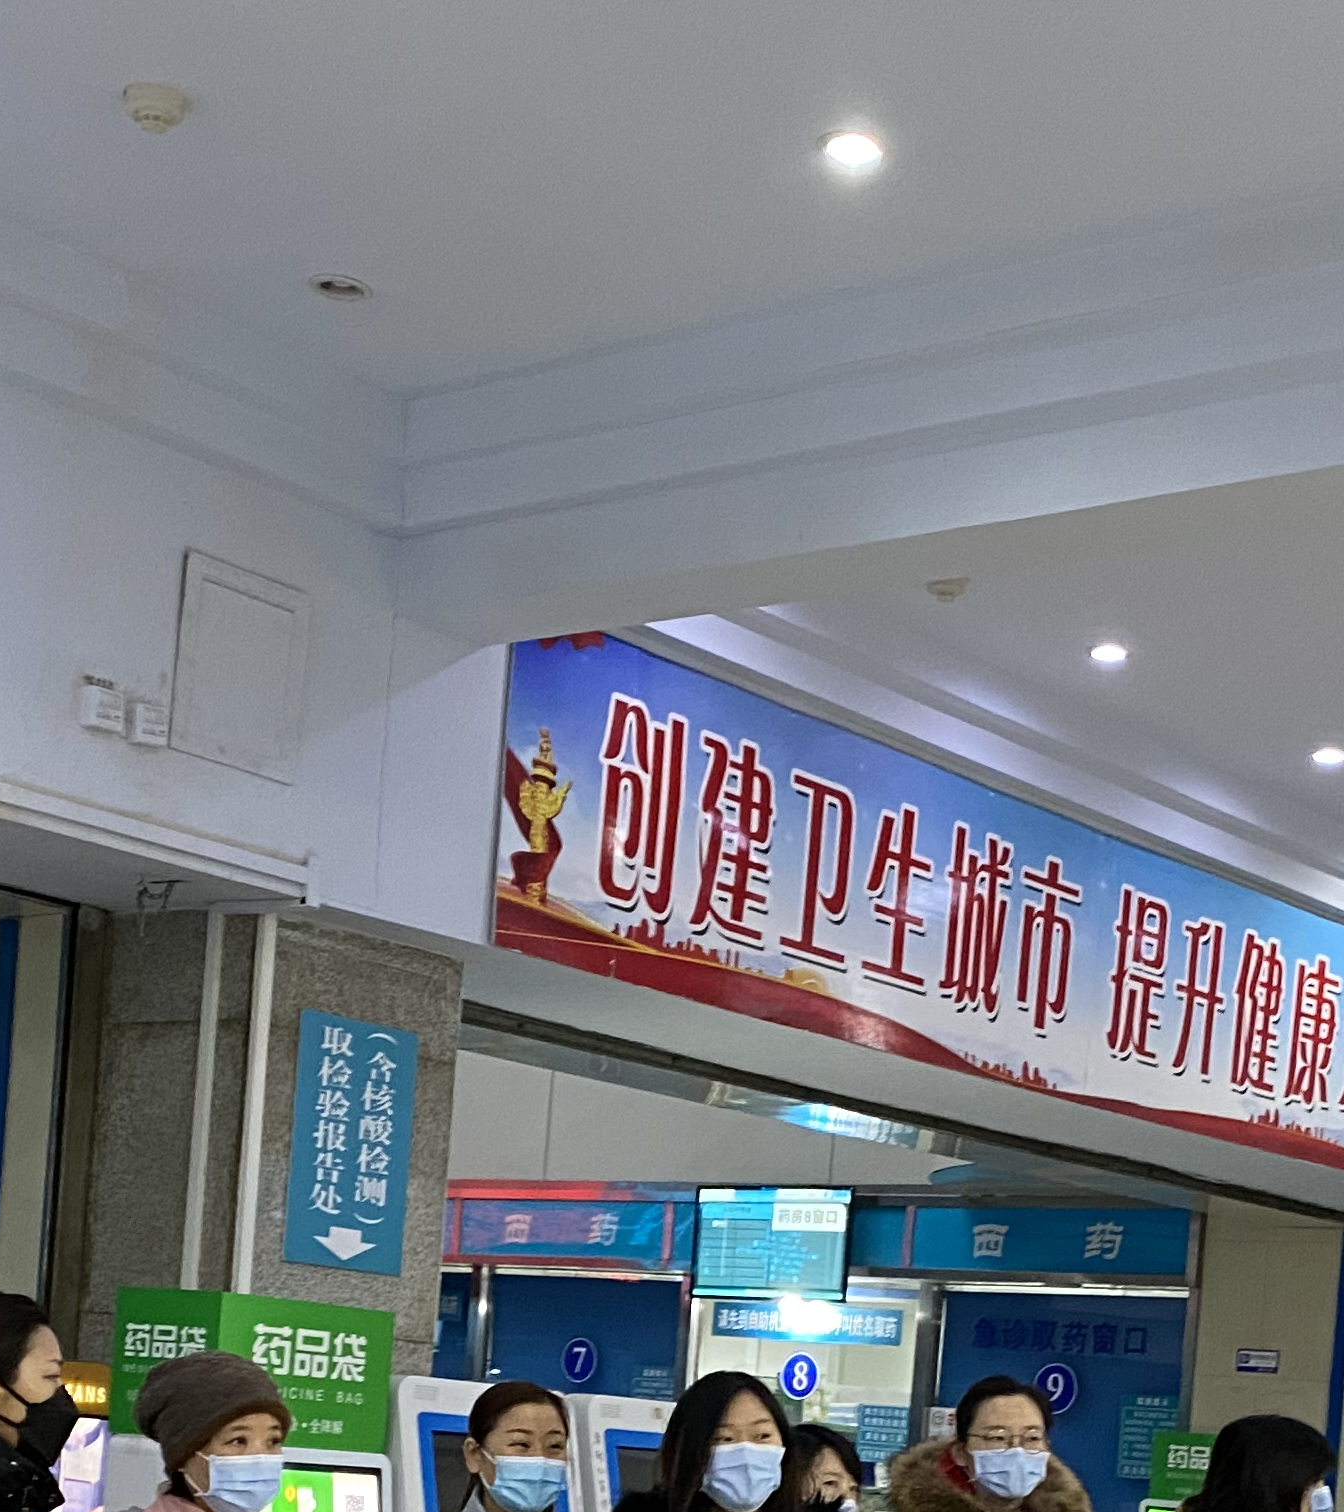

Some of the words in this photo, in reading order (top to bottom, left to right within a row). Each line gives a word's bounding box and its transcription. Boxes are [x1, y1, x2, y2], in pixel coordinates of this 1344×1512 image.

[598, 692, 1084, 1035] 创建卫生城市
[308, 1025, 355, 1215] 取检验报告处
[777, 1209, 838, 1225] 药房8窗口
[972, 1220, 1125, 1261] 西药
[124, 1322, 208, 1358] 药品袋
[251, 1323, 368, 1383] 药品袋
[973, 1317, 1148, 1355] 急诊取药窗口
[571, 1346, 588, 1374] 7
[791, 1360, 809, 1392] 8
[277, 1386, 325, 1402] ICINE
[336, 1391, 364, 1406] BAG
[1046, 1372, 1066, 1402] 9
